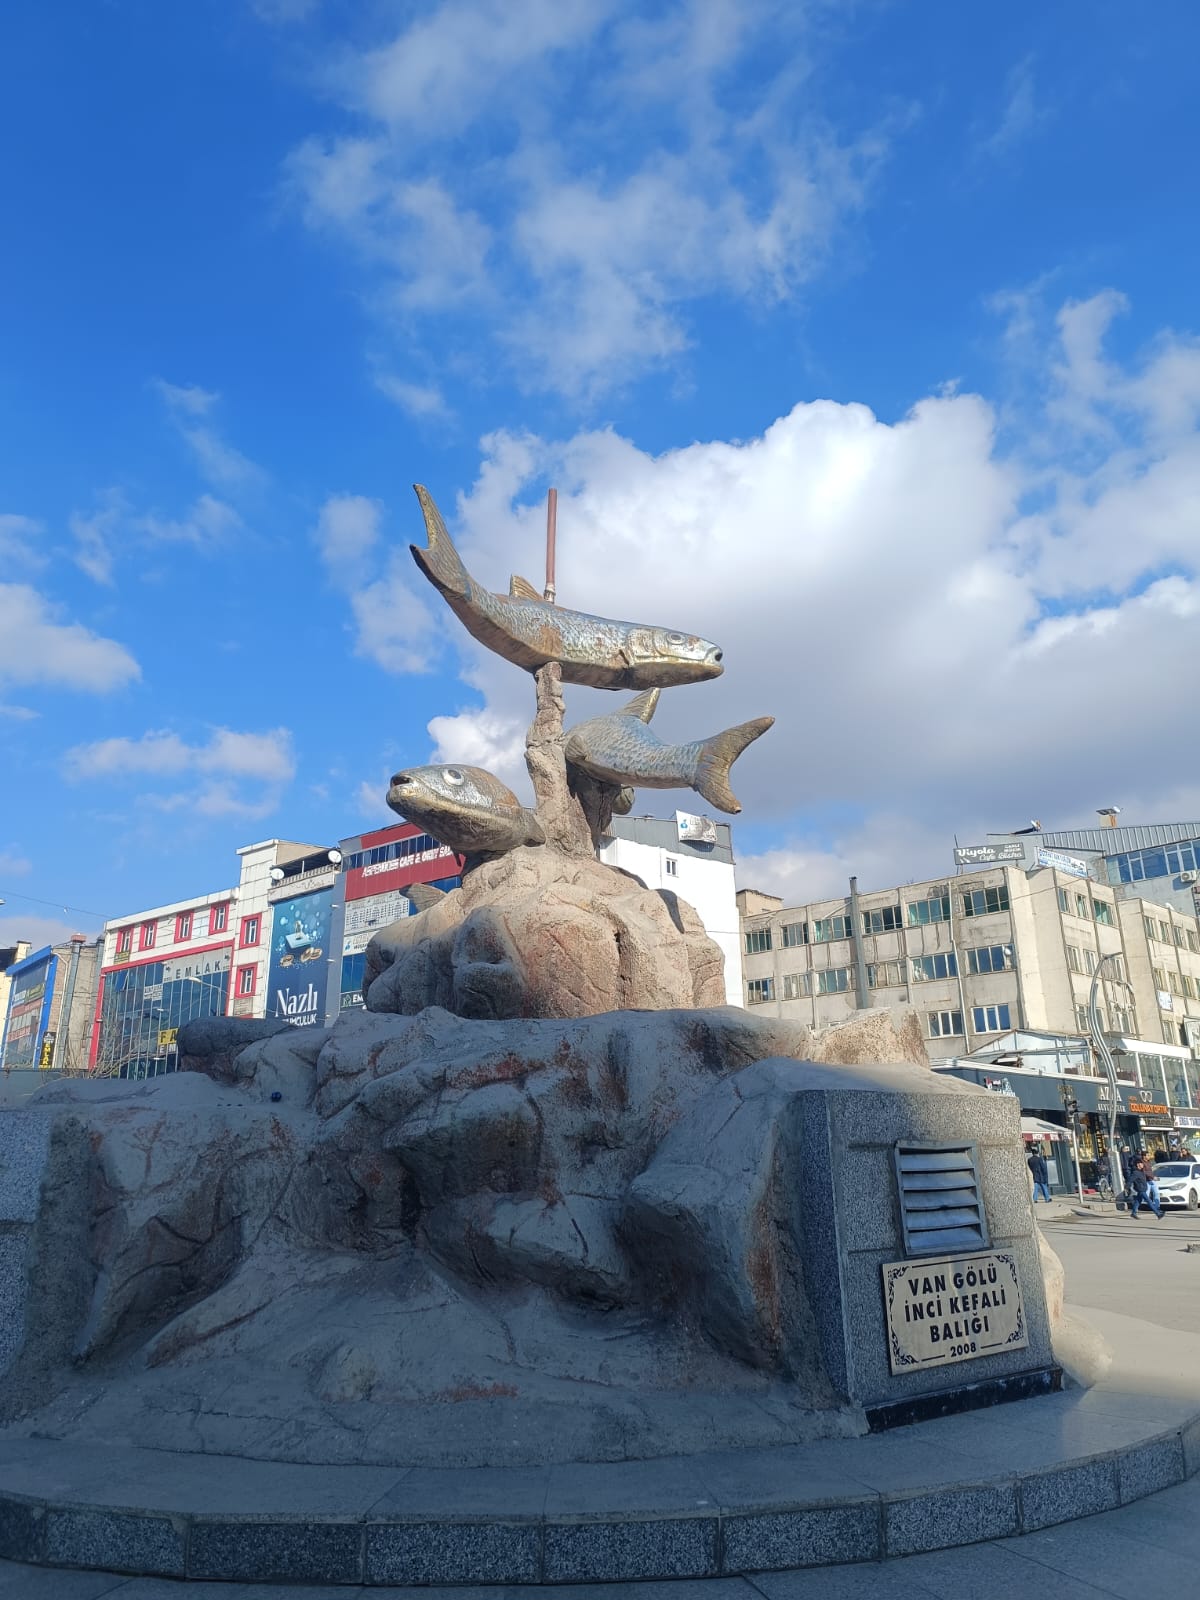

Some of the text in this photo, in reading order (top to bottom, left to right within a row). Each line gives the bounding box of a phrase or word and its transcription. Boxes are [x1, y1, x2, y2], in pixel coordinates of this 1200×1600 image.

[176, 961, 221, 977] EMLAK
[275, 983, 318, 1017] Nazlı
[1099, 1087, 1122, 1102] AZA
[908, 1263, 997, 1296] VAN GÖLÜ
[904, 1285, 1006, 1322] İNCİ KEFALİ
[930, 1312, 989, 1343] BALIĞI
[951, 1342, 977, 1357] 2008
